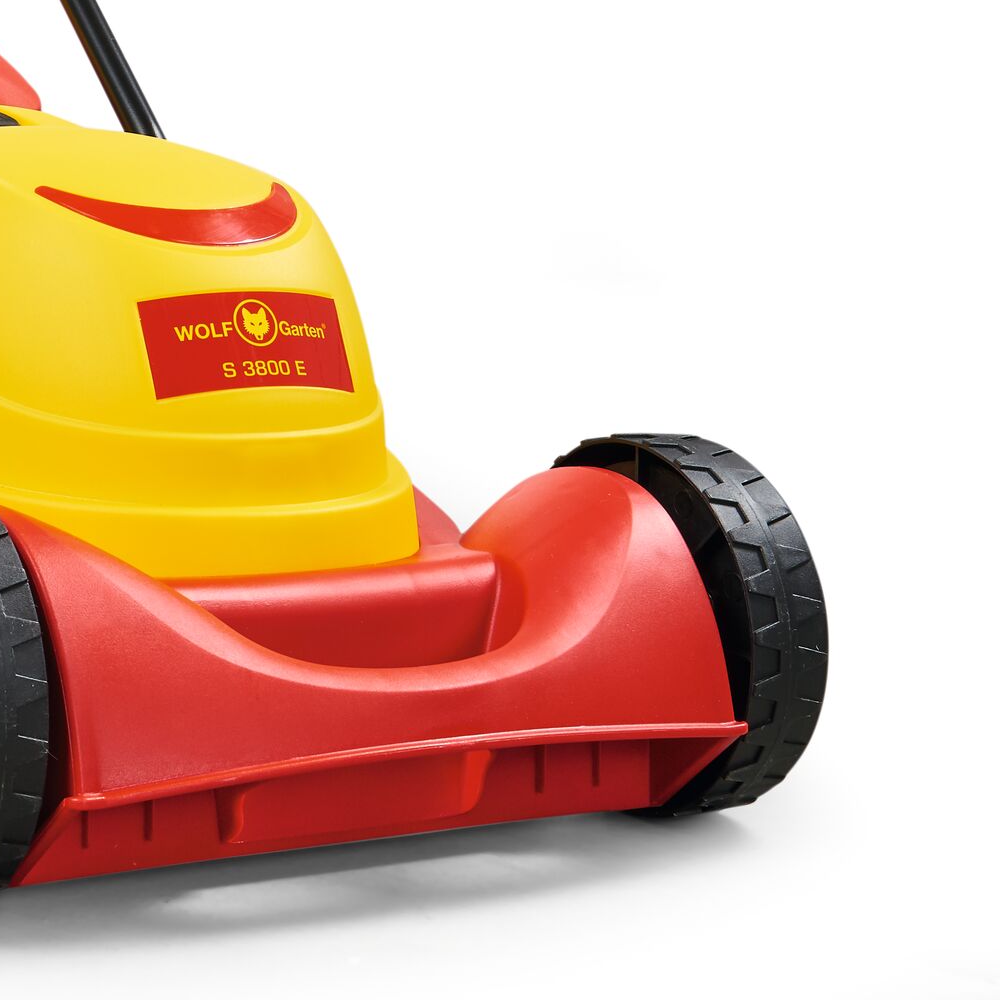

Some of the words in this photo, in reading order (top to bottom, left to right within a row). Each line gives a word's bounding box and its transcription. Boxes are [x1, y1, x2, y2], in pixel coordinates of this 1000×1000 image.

[174, 322, 233, 342] WOLF
[222, 362, 237, 378] S
[243, 360, 290, 376] 3800
[295, 361, 307, 376] E
